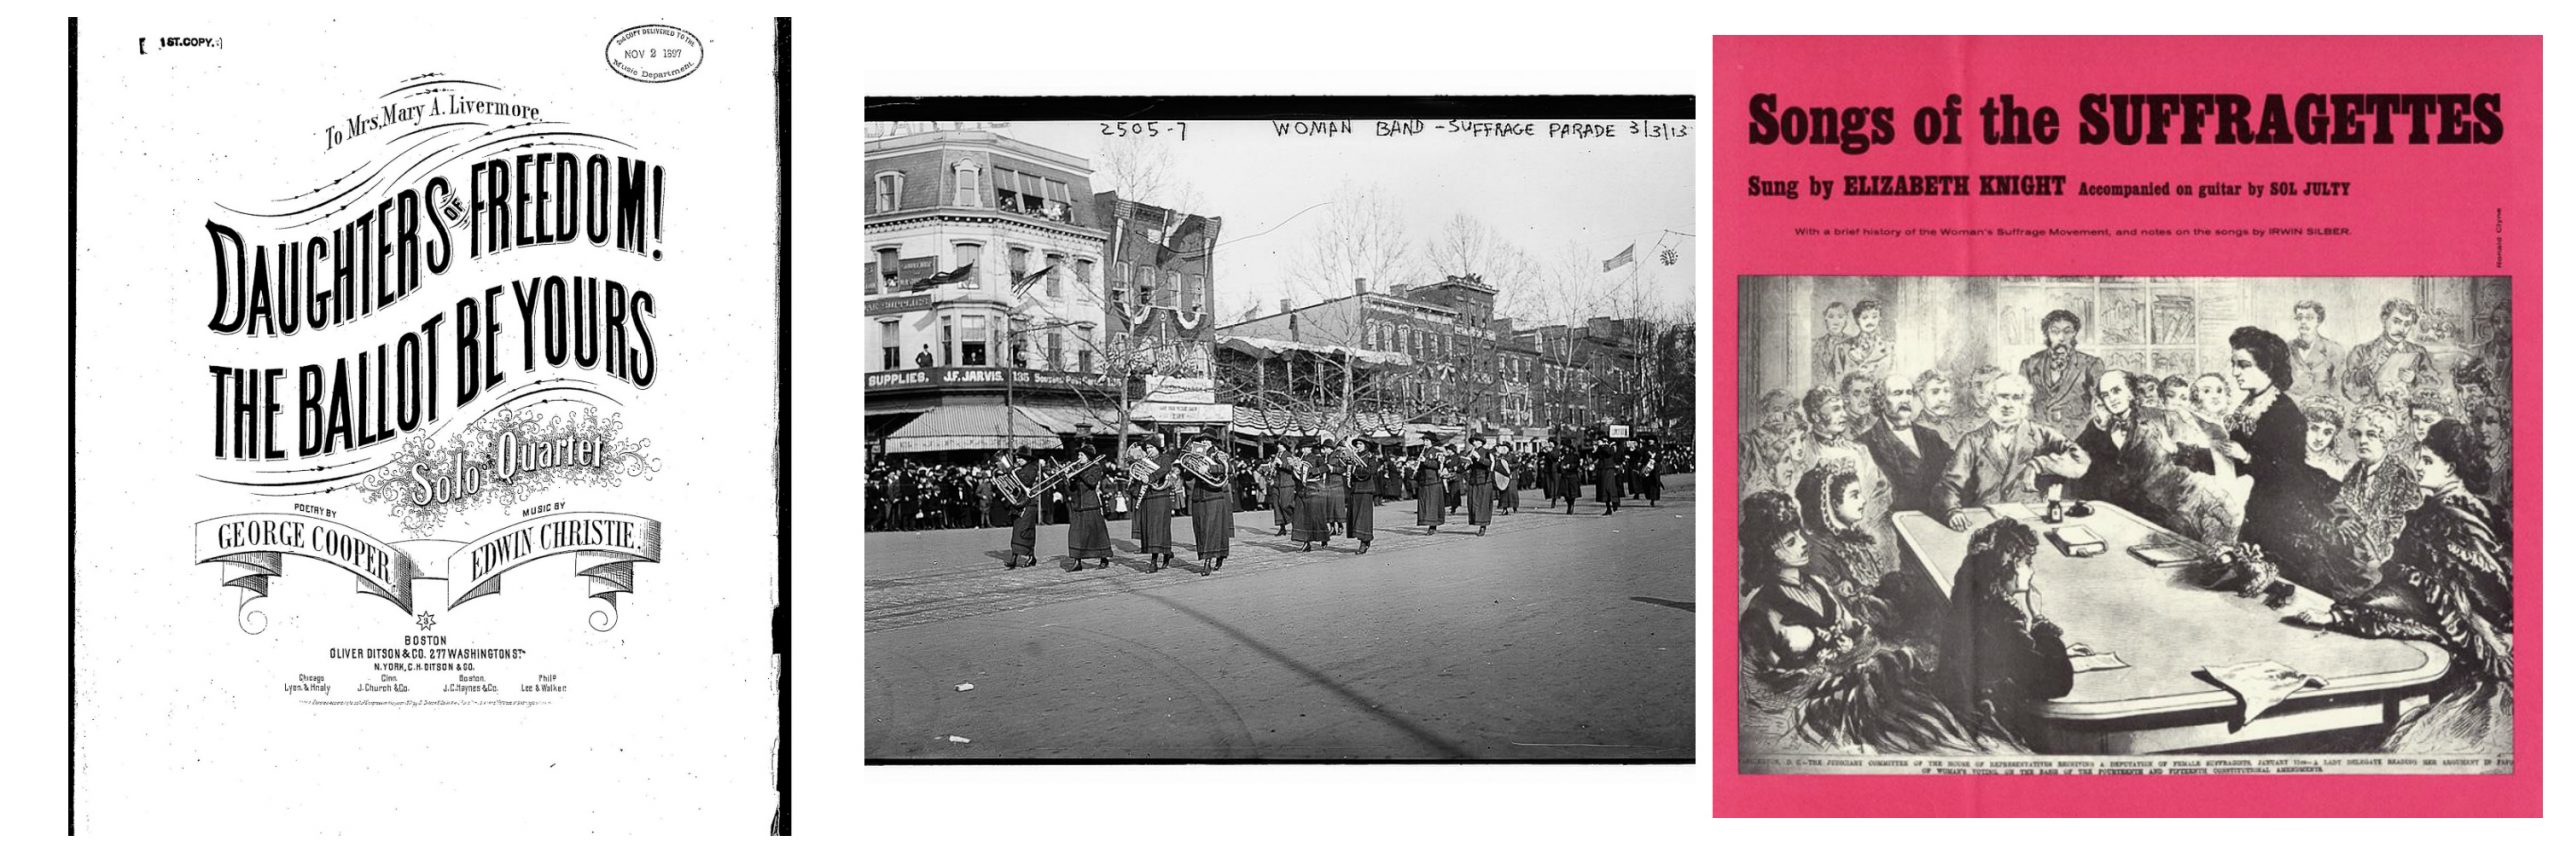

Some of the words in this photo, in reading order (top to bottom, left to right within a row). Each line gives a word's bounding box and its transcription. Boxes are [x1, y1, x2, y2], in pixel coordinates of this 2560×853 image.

[642, 28, 675, 37] DELIVERED
[677, 31, 685, 39] TO
[624, 49, 645, 59] NOV
[650, 48, 657, 58] 2
[325, 125, 343, 150] To
[381, 102, 426, 126] Mary
[429, 96, 446, 117] A.
[450, 94, 543, 122] Livermore.
[1273, 120, 1352, 136] WOMAN
[1376, 119, 1424, 136] BAND
[1549, 122, 1616, 139] PARADE
[1629, 119, 1688, 140] 3/3/13
[1749, 93, 1895, 154] Songs
[1913, 93, 1962, 145] of
[1980, 94, 2059, 145] the
[2079, 93, 2505, 145] SUFFRAGETTES
[1100, 122, 1186, 141] 2505-7
[1748, 175, 1799, 199] Sung
[1809, 175, 1834, 199] by
[1844, 175, 1970, 196] ELIZABETH
[1979, 175, 2066, 196] KNIGHT
[2078, 182, 2170, 199] Accompanied
[2176, 184, 2193, 197] on
[2198, 182, 2242, 199] guitar
[2248, 182, 2264, 199] by
[2270, 182, 2297, 196] SOL
[2303, 182, 2351, 196] JULTY
[1795, 227, 1820, 236] With
[1834, 227, 1860, 236] brief
[1863, 227, 1901, 238] history
[1905, 227, 1916, 236] of
[1919, 227, 1937, 236] the
[1940, 227, 1993, 236] Woman's
[1997, 227, 2046, 238] Suffrage
[2049, 227, 2112, 238] Movement,
[2115, 227, 2138, 236] and
[2141, 228, 2172, 236] notes
[2193, 227, 2211, 236] the
[2215, 228, 2249, 238] songs
[2252, 227, 2266, 238] by
[2269, 227, 2303, 236] IRWIN
[2306, 227, 2352, 236] SILBER.
[205, 175, 455, 338] DAUGHTERS
[443, 196, 464, 221] OF
[470, 151, 666, 262] FREEDOM!
[209, 363, 288, 461] THE
[299, 311, 446, 460] BALLOT
[456, 284, 506, 408] BE
[512, 275, 658, 391] YOURS
[868, 371, 930, 386] SUPPLIES.
[411, 450, 480, 506] Solo
[497, 431, 604, 485] Quartet
[293, 502, 322, 516] POETRY
[324, 509, 337, 519] BY
[521, 505, 551, 517] MUSIC
[554, 501, 566, 511] BY
[216, 520, 305, 550] GEORGE
[471, 527, 534, 583] EDWIN
[404, 635, 447, 646] BOSTON
[329, 648, 364, 660] OLIVER
[366, 648, 401, 660] DITSON
[429, 648, 446, 660] 277
[447, 648, 511, 660] WASHINGTON
[424, 663, 455, 671] DITSON
[298, 673, 326, 684] Chicago
[364, 682, 393, 693] Church
